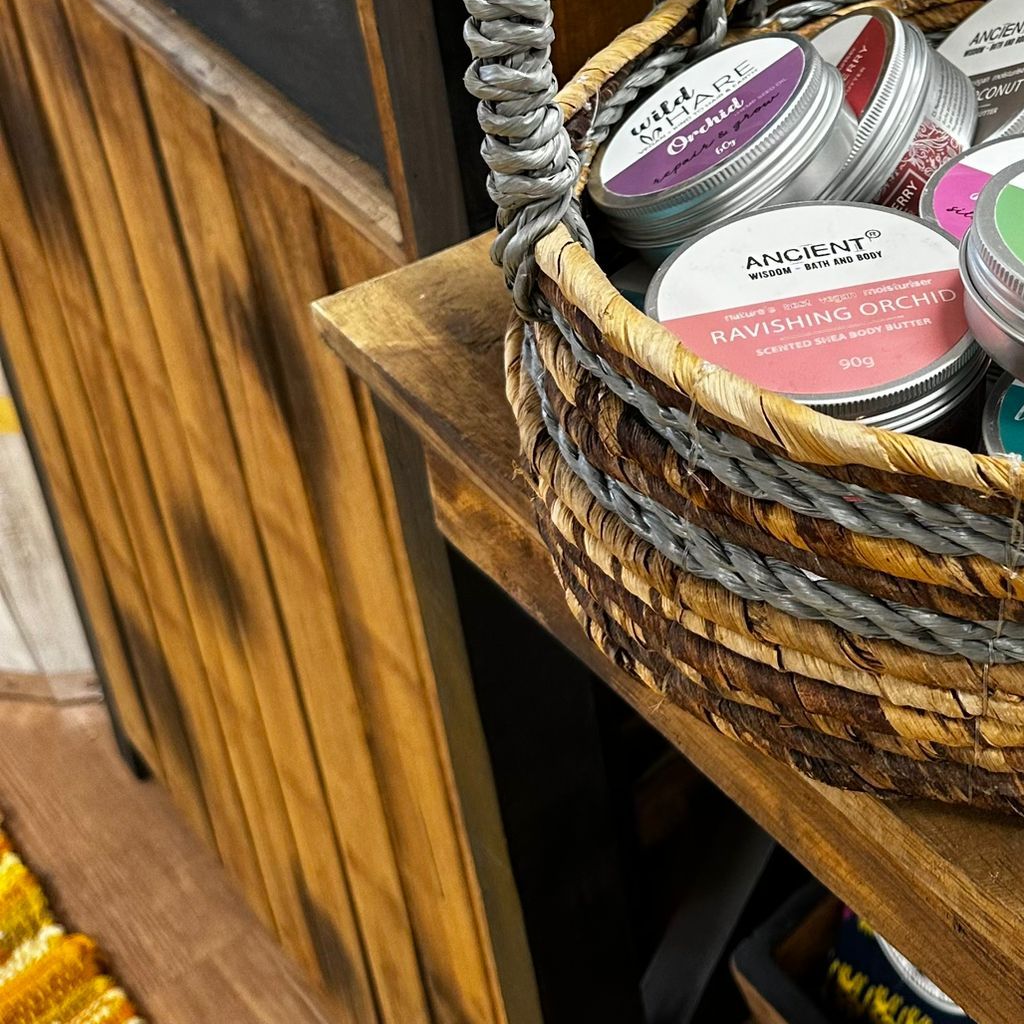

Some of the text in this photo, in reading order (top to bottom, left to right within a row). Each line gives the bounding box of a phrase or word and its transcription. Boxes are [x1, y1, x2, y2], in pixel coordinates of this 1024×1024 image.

[631, 86, 695, 136] wild
[665, 60, 756, 126] HARE
[733, 93, 780, 131] grow
[667, 97, 745, 156] Orchid
[715, 139, 736, 156] 60g
[748, 266, 792, 281] WISDOM
[805, 259, 830, 272] BATH
[833, 255, 854, 267] AND
[857, 250, 883, 263] BODY
[863, 278, 933, 297] moisturiser
[710, 288, 957, 346] RAVISHING ORCHID
[756, 317, 932, 357] SCENTED SHEA BODY BUTTER
[838, 355, 876, 371] 90g
